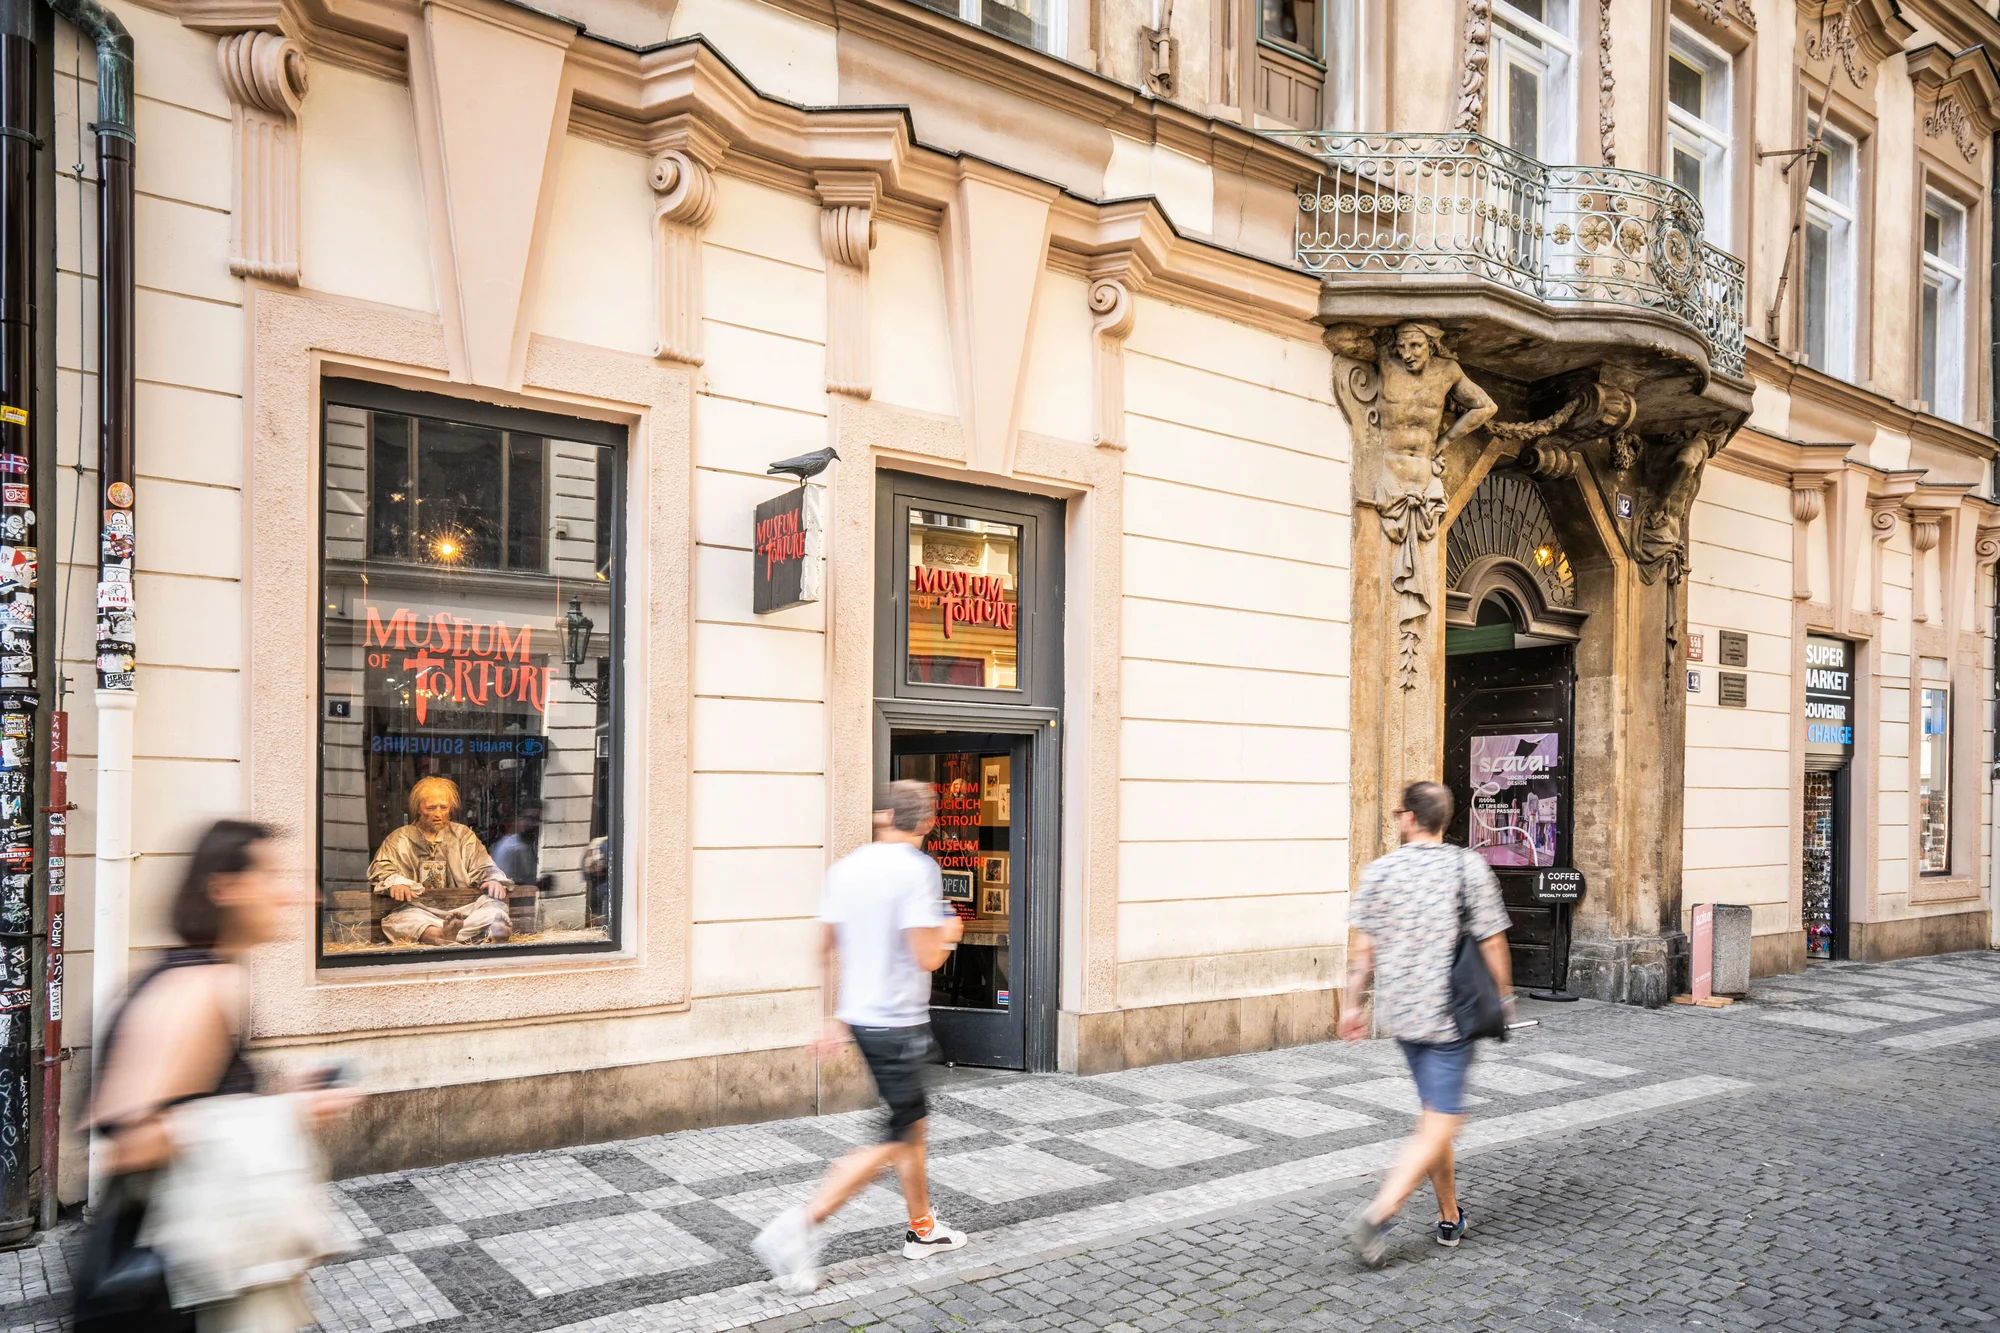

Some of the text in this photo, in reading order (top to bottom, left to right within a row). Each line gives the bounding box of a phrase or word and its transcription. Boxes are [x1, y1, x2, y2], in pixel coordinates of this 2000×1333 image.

[756, 508, 799, 546] MUSEUM
[766, 531, 806, 582] TORTURE
[915, 566, 1004, 602] MUSEUM
[918, 592, 1017, 639] OF TORTURE
[362, 606, 533, 664] MUSEUM
[1805, 644, 1844, 667] SUPER
[368, 648, 560, 726] OF TORTURE
[1690, 675, 1699, 687] 12
[1805, 723, 1852, 745] CHANGE
[930, 812, 982, 827] ÁSTROJŮ
[927, 840, 979, 852] MUSEUM
[937, 856, 987, 868] TORTURE
[943, 878, 968, 893] OPEN
[1547, 872, 1581, 881] COFFEE
[1550, 883, 1577, 891] ROOM
[51, 912, 64, 947] MROK
[53, 953, 63, 987] KSG
